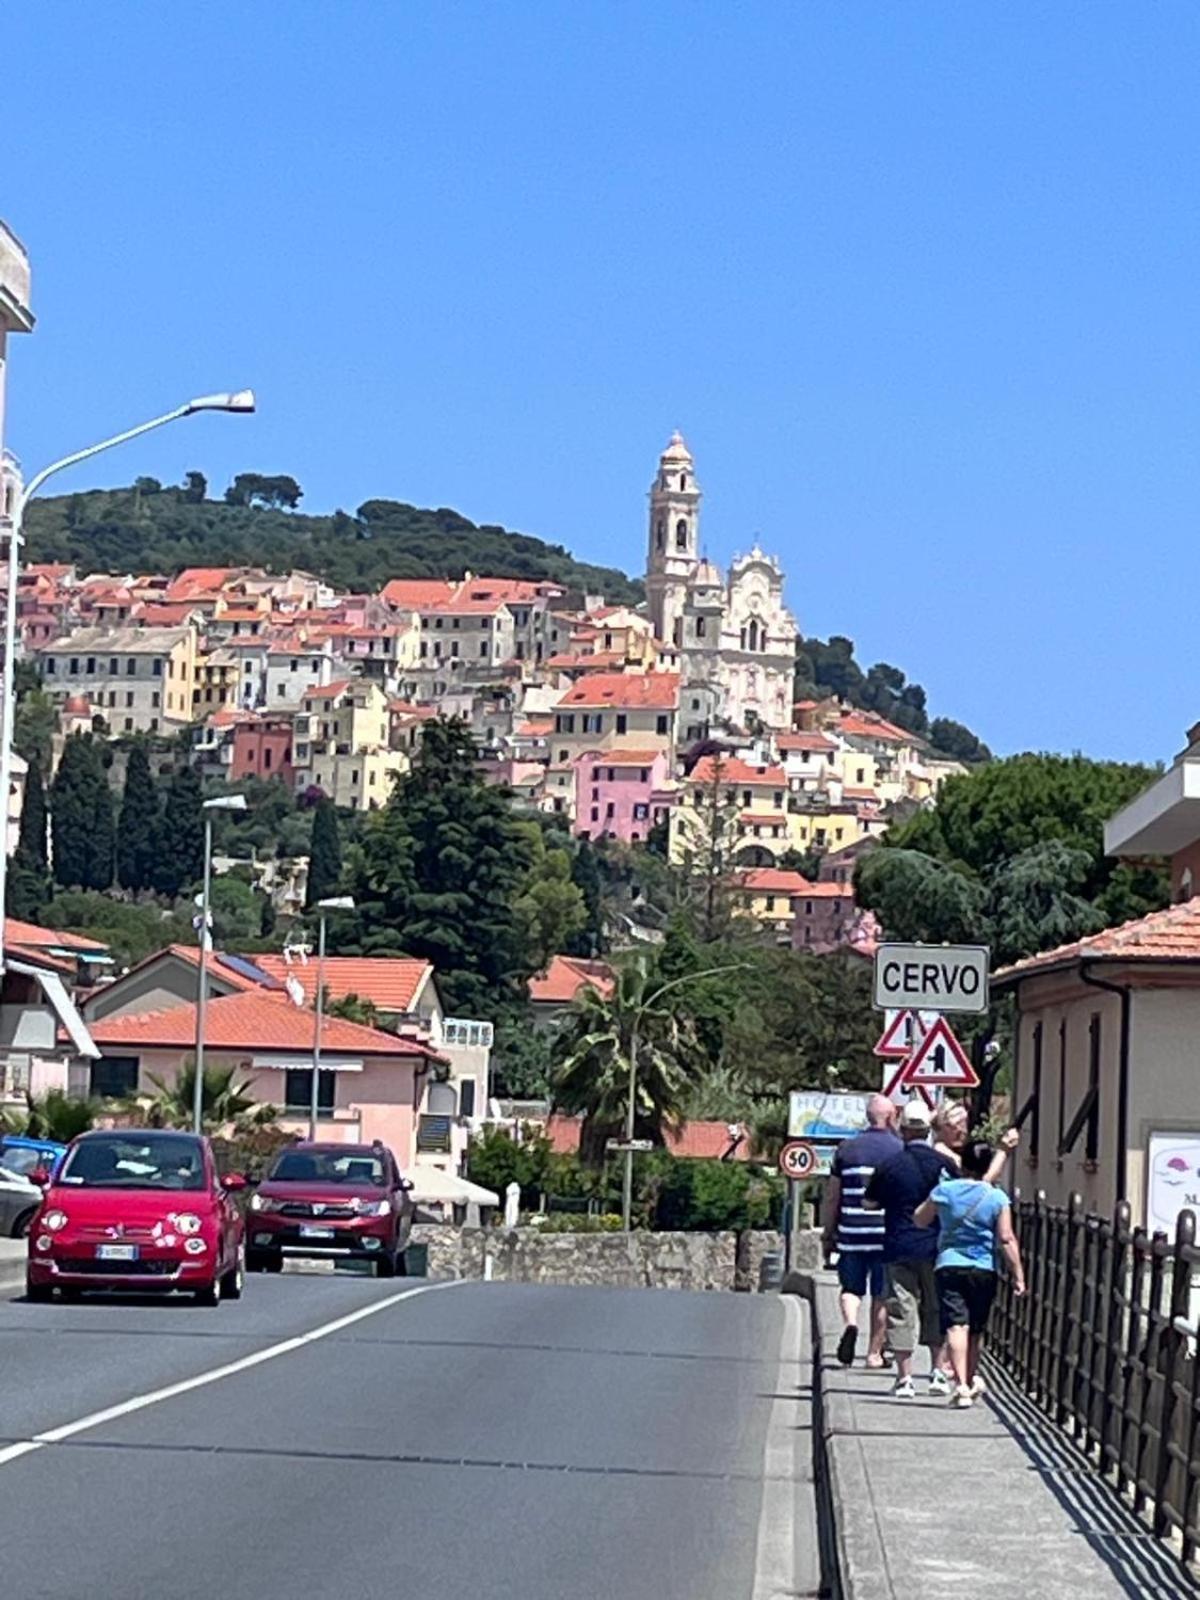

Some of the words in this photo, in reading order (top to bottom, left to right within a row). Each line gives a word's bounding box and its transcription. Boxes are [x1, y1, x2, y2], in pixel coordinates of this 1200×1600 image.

[883, 962, 979, 995] CERVO
[797, 1097, 865, 1112] HOTEL
[788, 1151, 808, 1168] 50
